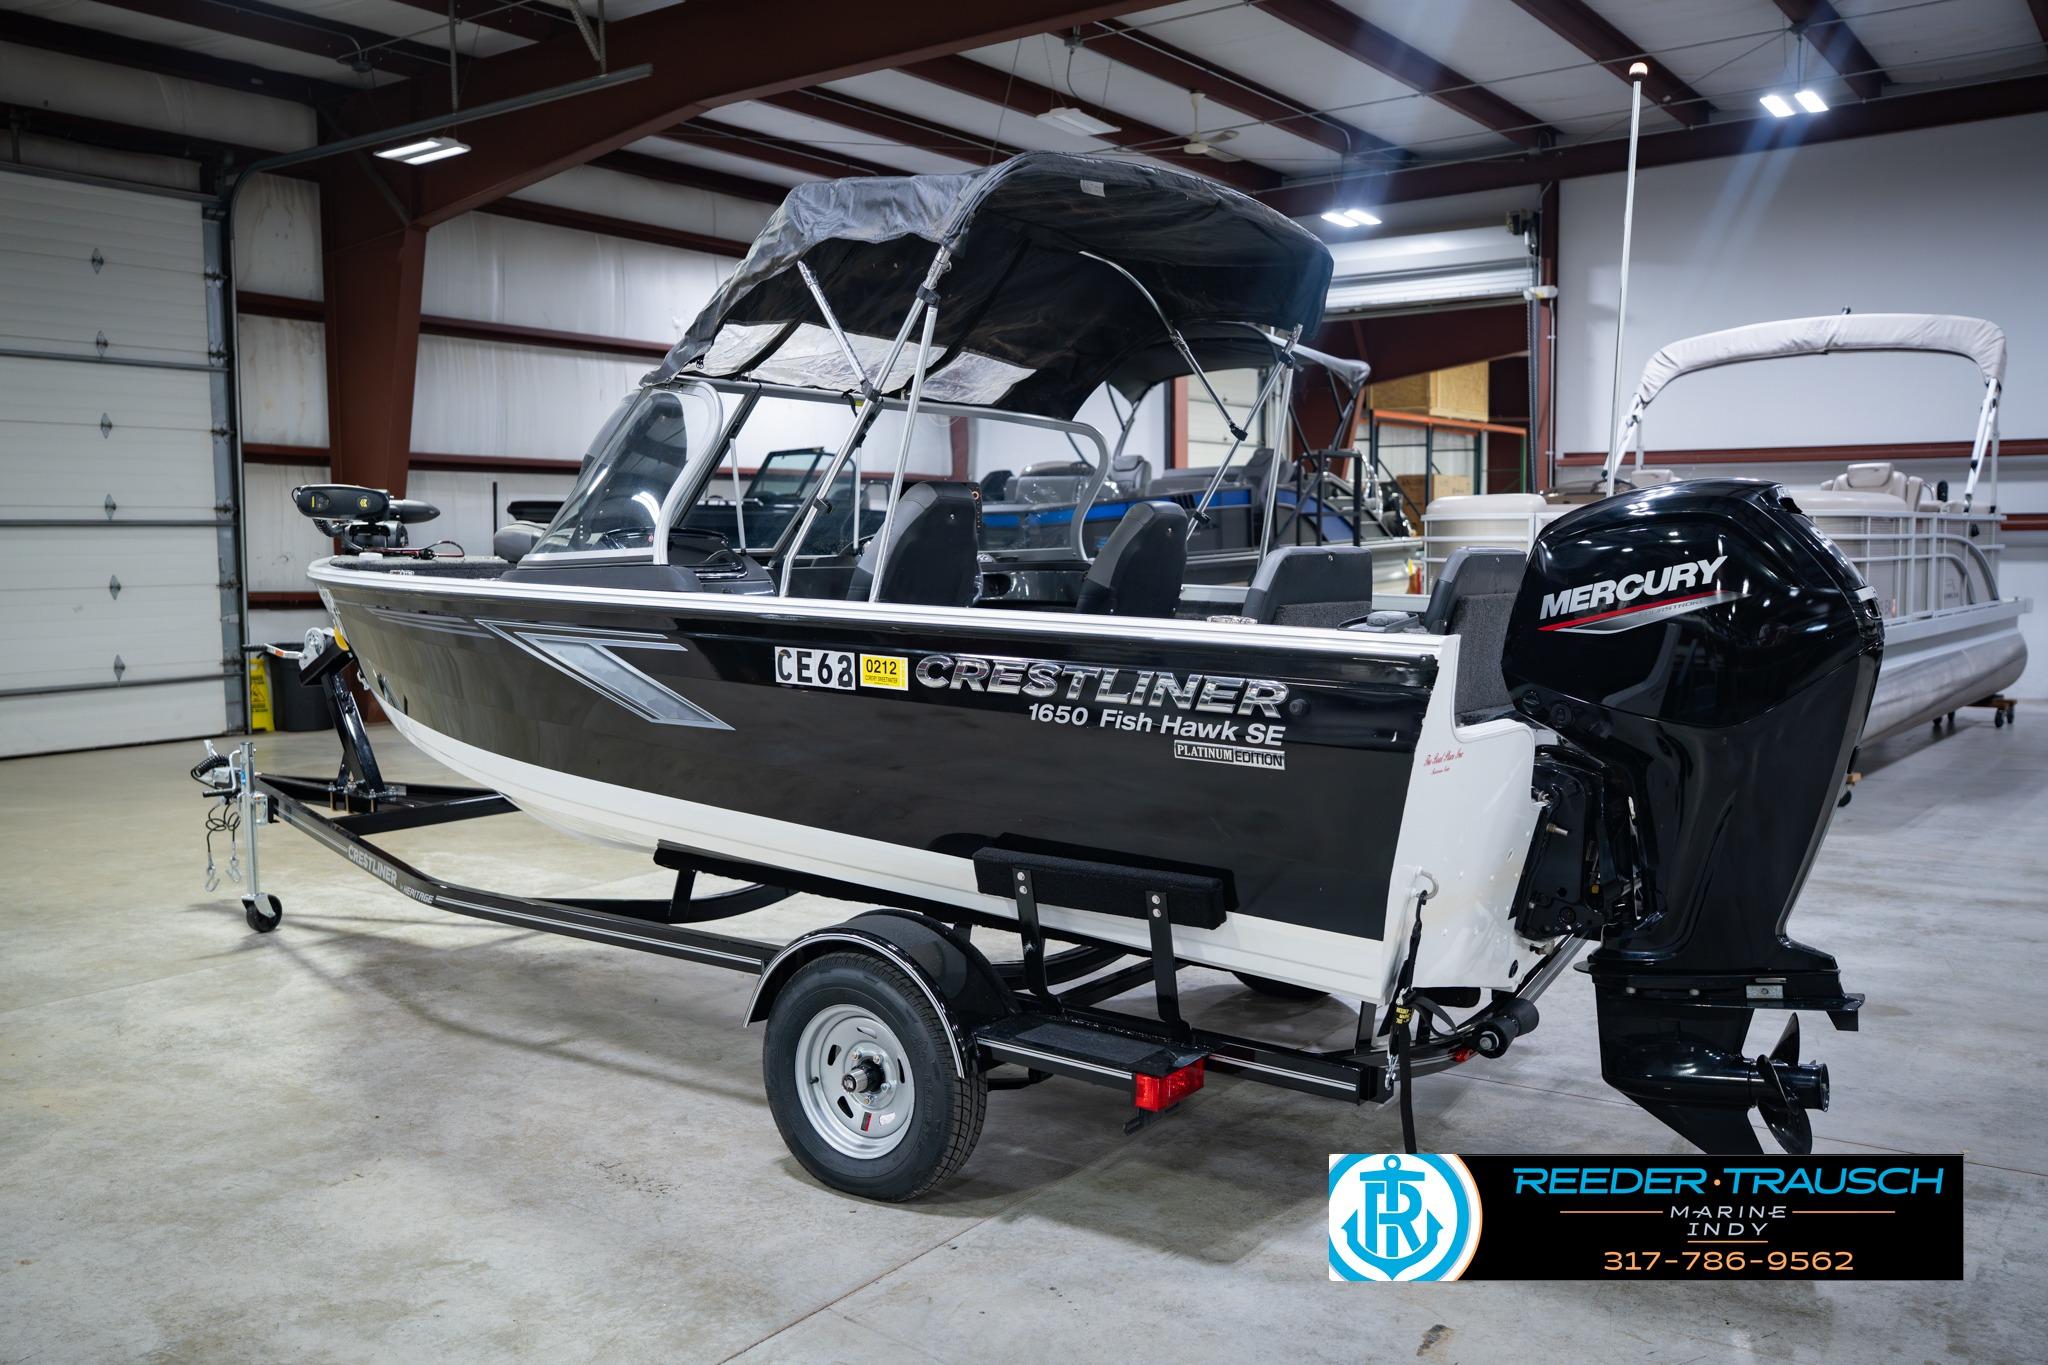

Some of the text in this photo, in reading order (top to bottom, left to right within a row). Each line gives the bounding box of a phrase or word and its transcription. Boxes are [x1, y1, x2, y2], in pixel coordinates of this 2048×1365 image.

[1540, 556, 1728, 620] MERCURY
[866, 659, 896, 675] 0212
[915, 655, 1290, 719] CRESTLINER
[1029, 703, 1286, 746] 1650 Fish Hawk SE
[1177, 744, 1283, 767] PLATINUM EDITION
[348, 845, 398, 887] CRESTLINER
[403, 885, 434, 904] HERITAGE
